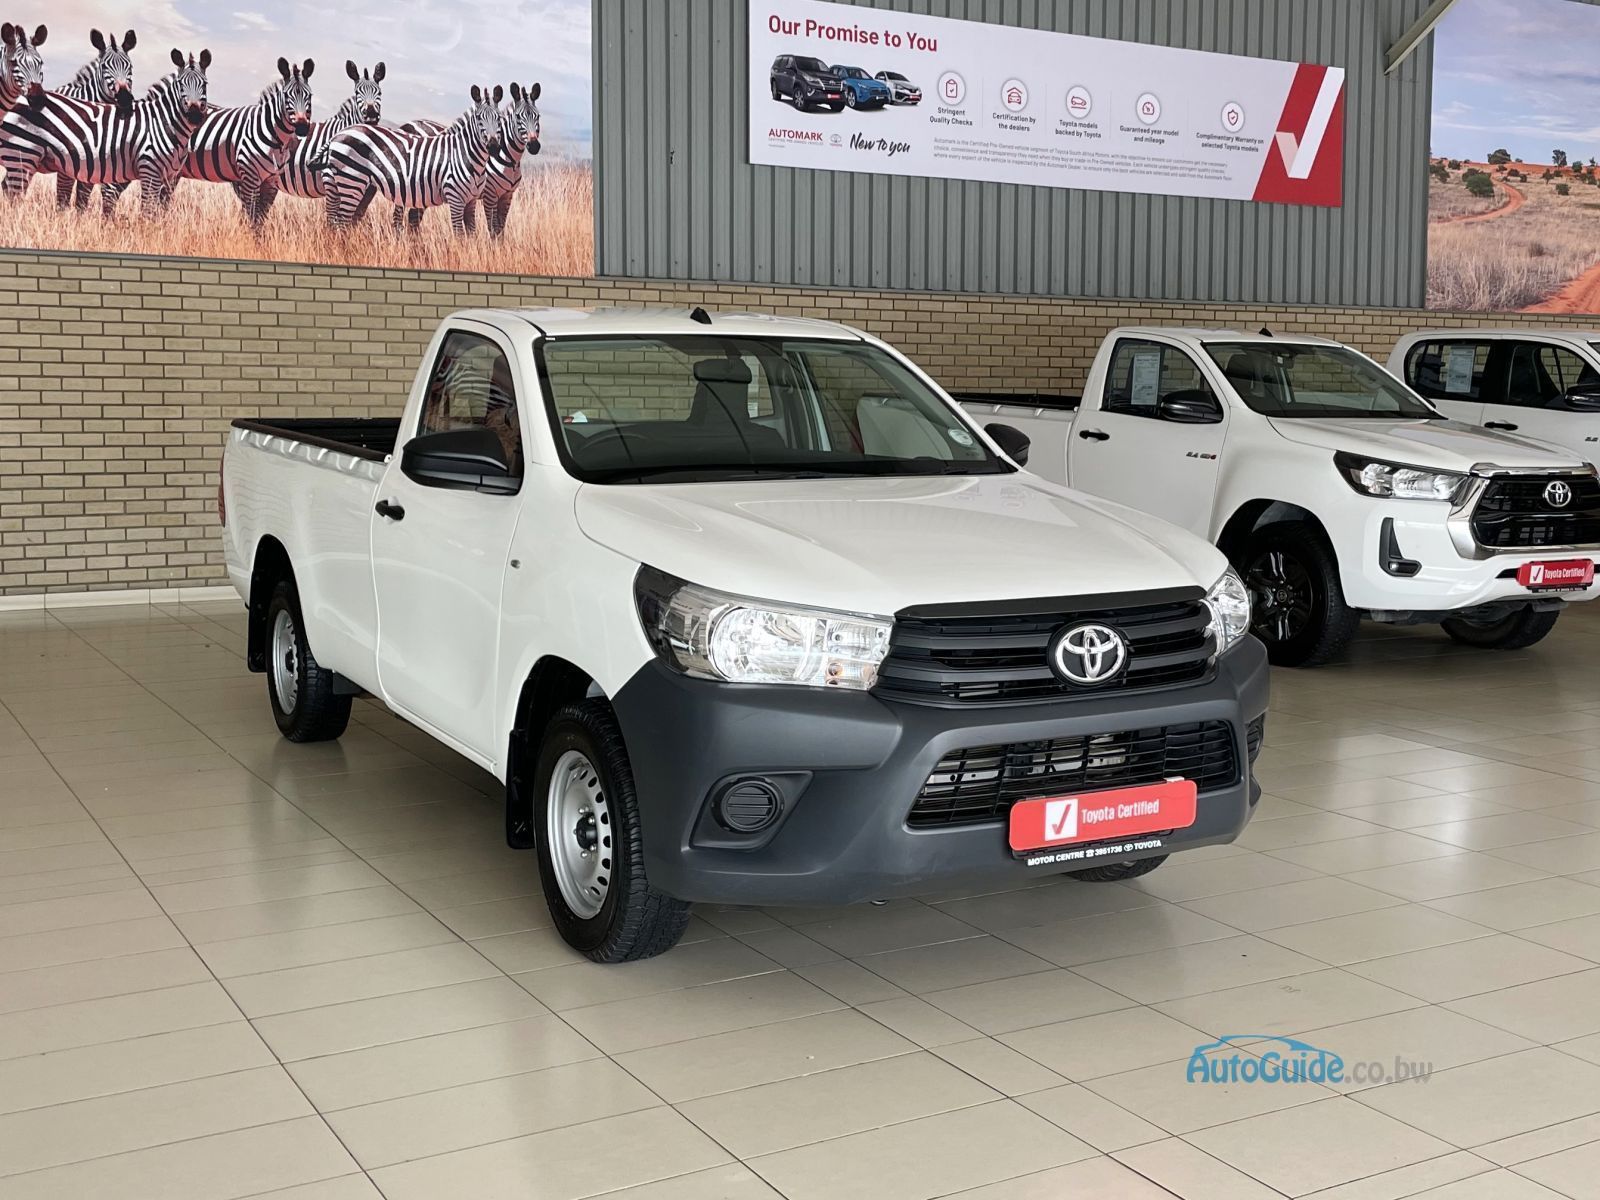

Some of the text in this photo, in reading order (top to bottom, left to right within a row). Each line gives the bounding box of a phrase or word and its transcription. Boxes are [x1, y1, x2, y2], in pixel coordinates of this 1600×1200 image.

[768, 14, 937, 52] Our Promise to You
[938, 106, 965, 116] Stringent
[930, 116, 972, 126] Quality Checks
[992, 112, 1028, 122] Certification
[1059, 120, 1077, 128] Toyota
[1120, 125, 1150, 134] Guaranteed
[768, 128, 823, 141] AUTOMARK
[1196, 132, 1234, 142] Complimentary
[1235, 136, 1257, 144] Warranty
[850, 132, 875, 150] New
[888, 141, 910, 156] you
[1545, 568, 1585, 579] Toyota Certified
[1082, 799, 1159, 824] Toyota Certified
[1027, 855, 1055, 866] MOTOR
[1056, 851, 1085, 861] CENTRE
[1134, 840, 1162, 850] TOYOTA
